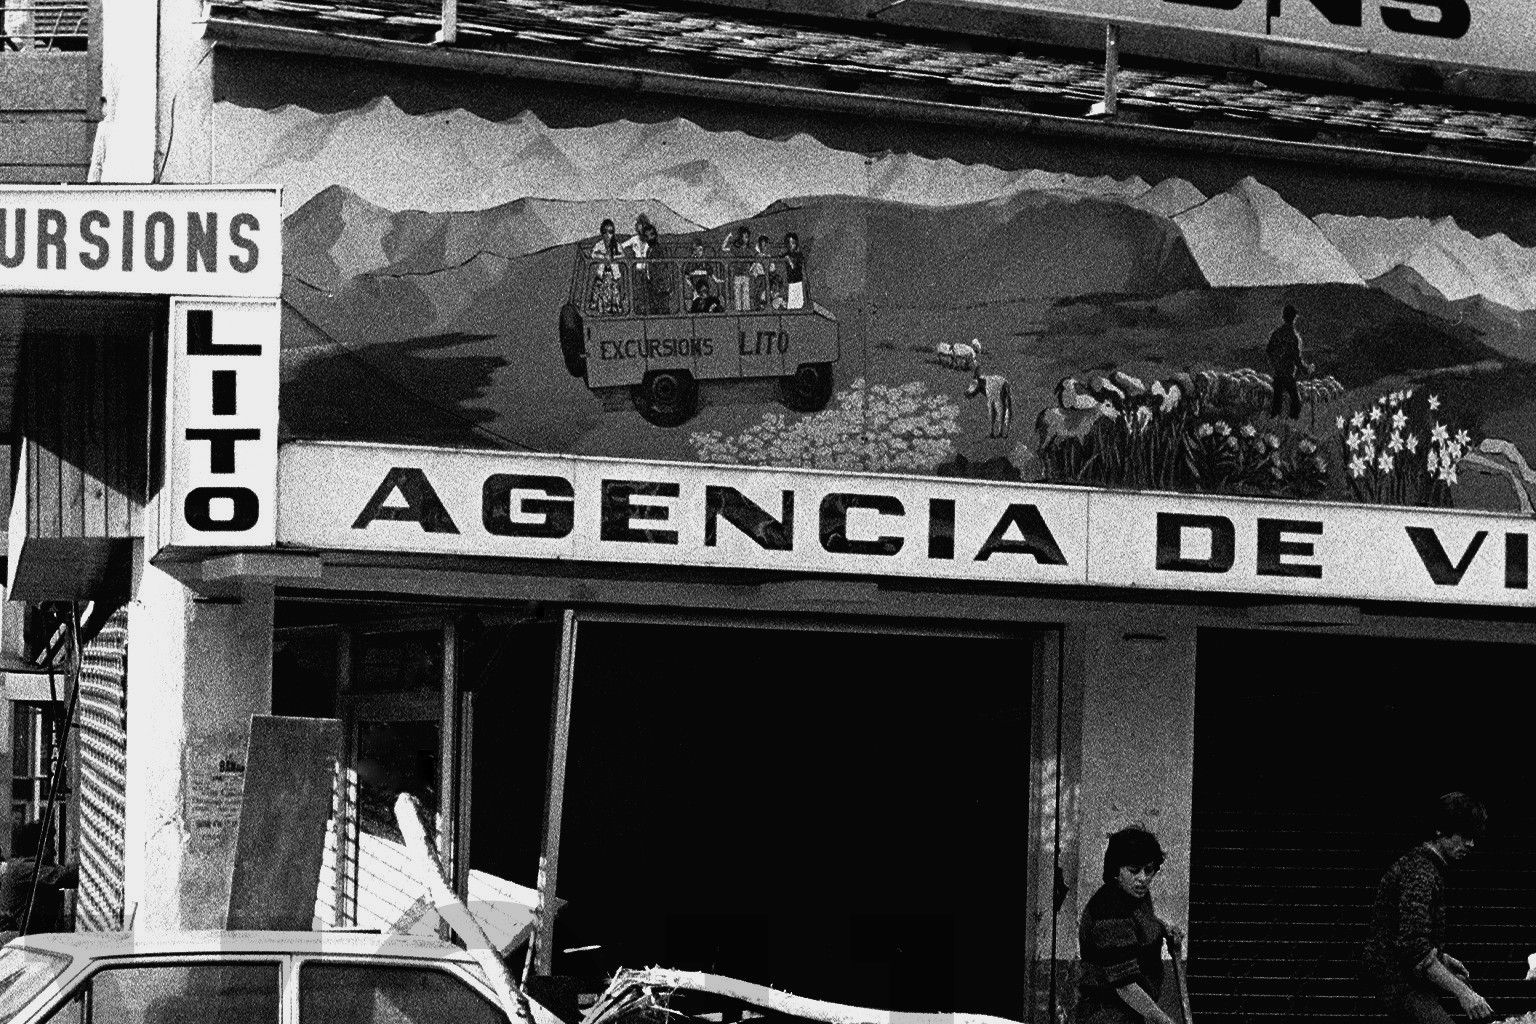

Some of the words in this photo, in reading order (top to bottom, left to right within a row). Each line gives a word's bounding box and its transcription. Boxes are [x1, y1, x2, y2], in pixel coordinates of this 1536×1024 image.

[600, 338, 714, 360] EXCURSIONS
[738, 331, 790, 355] LITO
[183, 309, 262, 532] LITO
[351, 466, 1068, 566] AGENCIA
[1155, 511, 1324, 579] DE
[1404, 526, 1529, 590] VI
